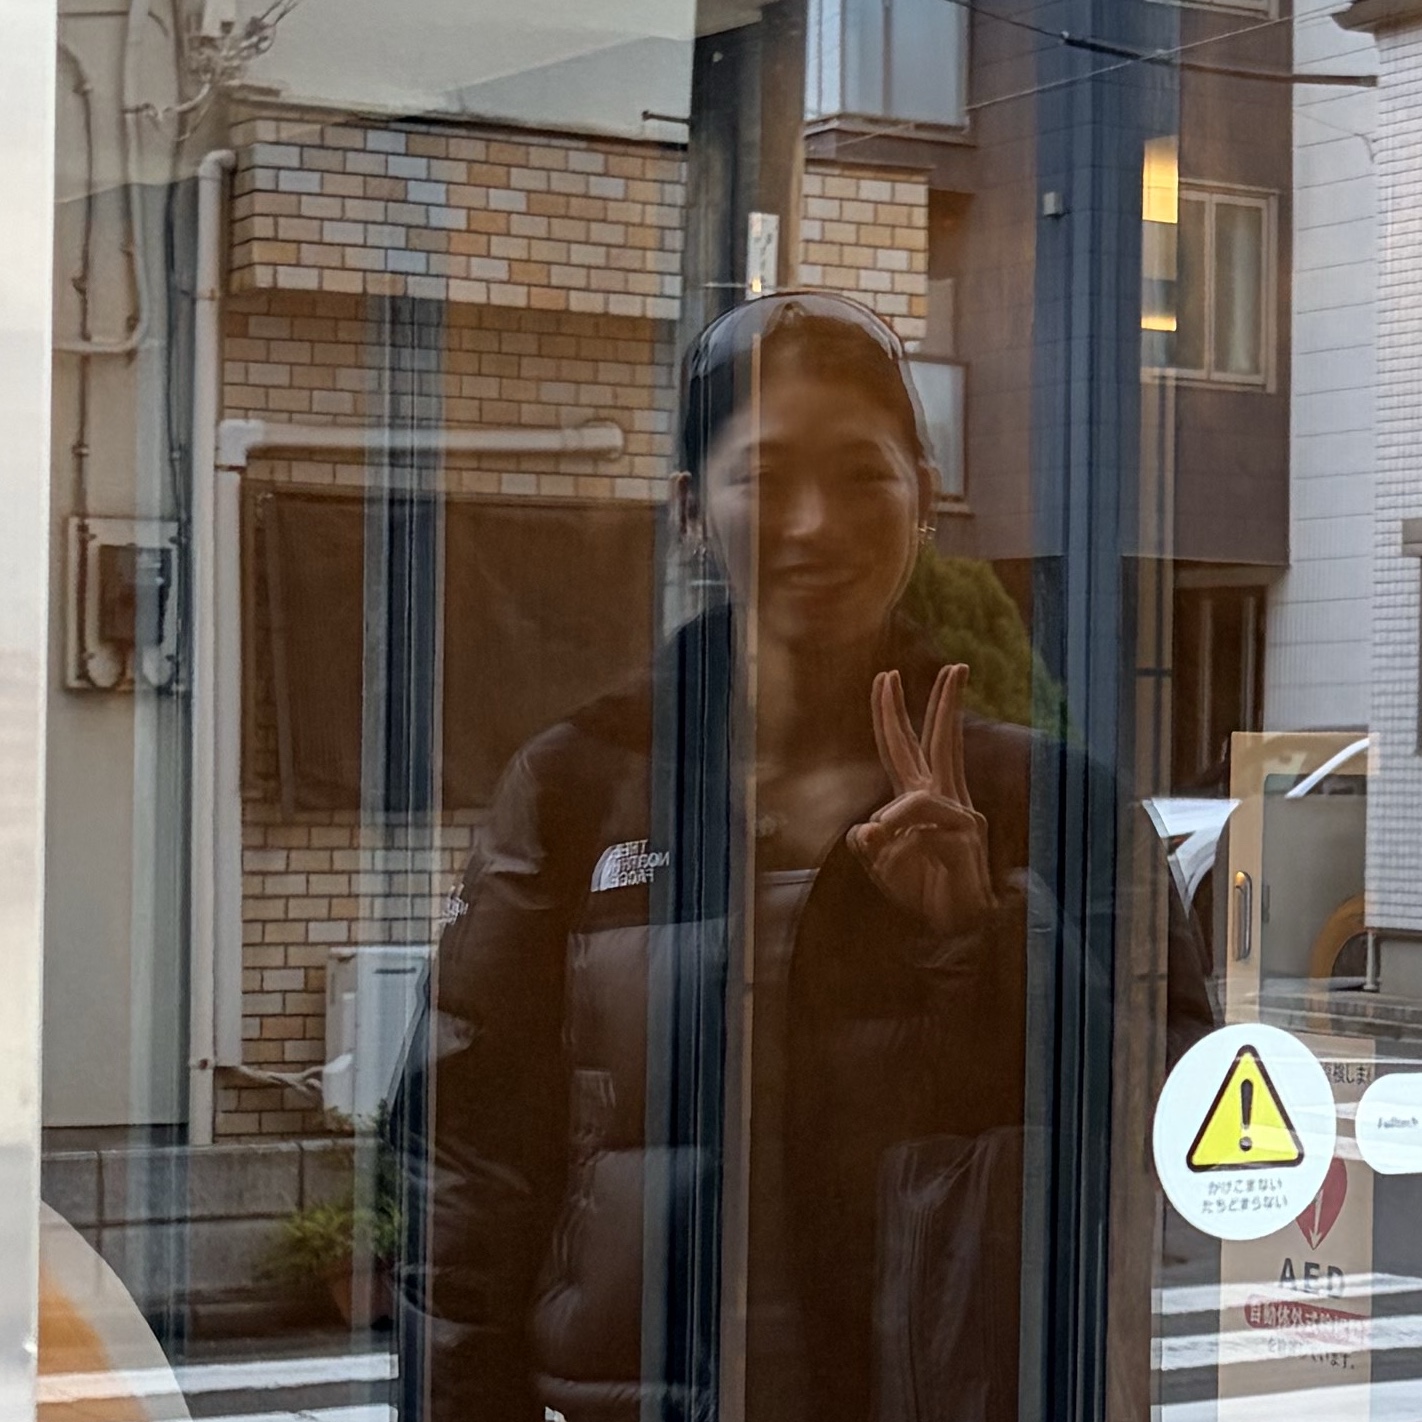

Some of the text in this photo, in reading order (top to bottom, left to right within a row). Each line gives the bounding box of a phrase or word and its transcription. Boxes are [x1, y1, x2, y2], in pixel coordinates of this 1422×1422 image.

[1208, 1178, 1283, 1196] かけこまない
[1202, 1195, 1288, 1214] たちどまらない
[1278, 1257, 1345, 1299] AED
